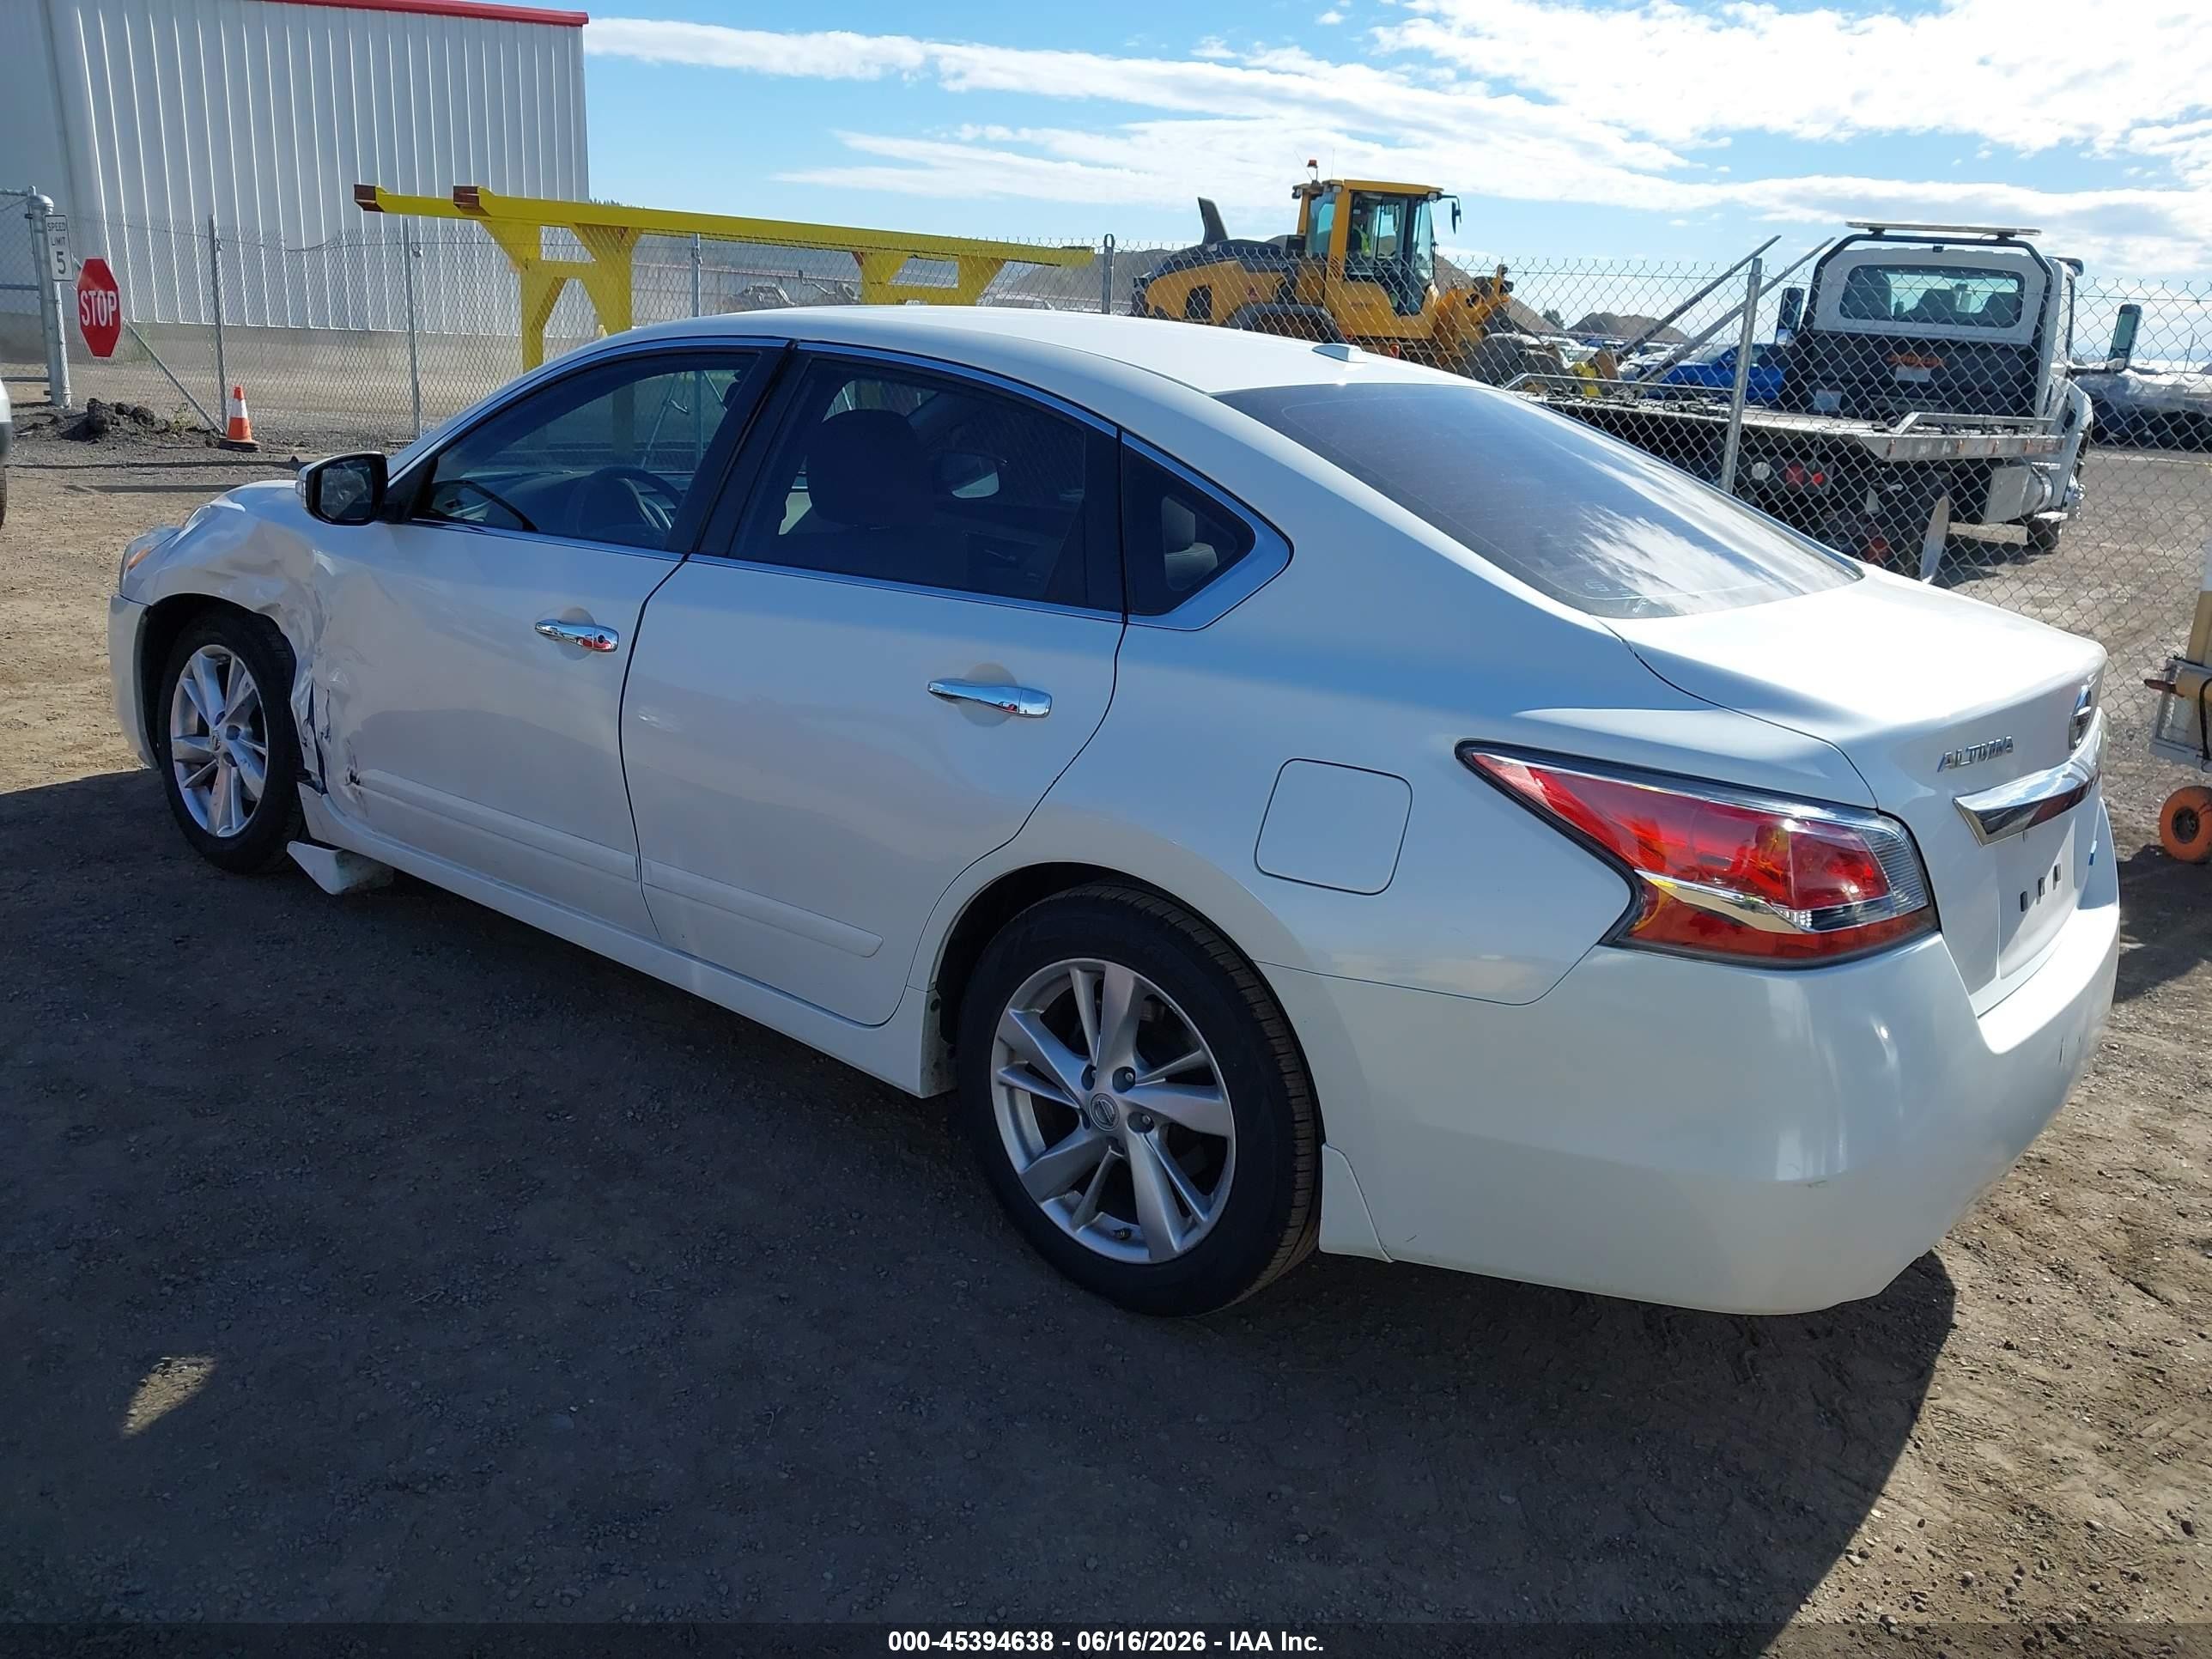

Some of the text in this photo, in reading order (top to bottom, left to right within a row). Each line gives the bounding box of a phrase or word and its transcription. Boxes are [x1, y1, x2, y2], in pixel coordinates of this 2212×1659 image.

[47, 222, 66, 231] SPEED
[52, 236, 66, 246] LIMIT
[56, 251, 66, 274] 5
[80, 290, 118, 327] STOP
[1937, 736, 2014, 773] ALTIMA
